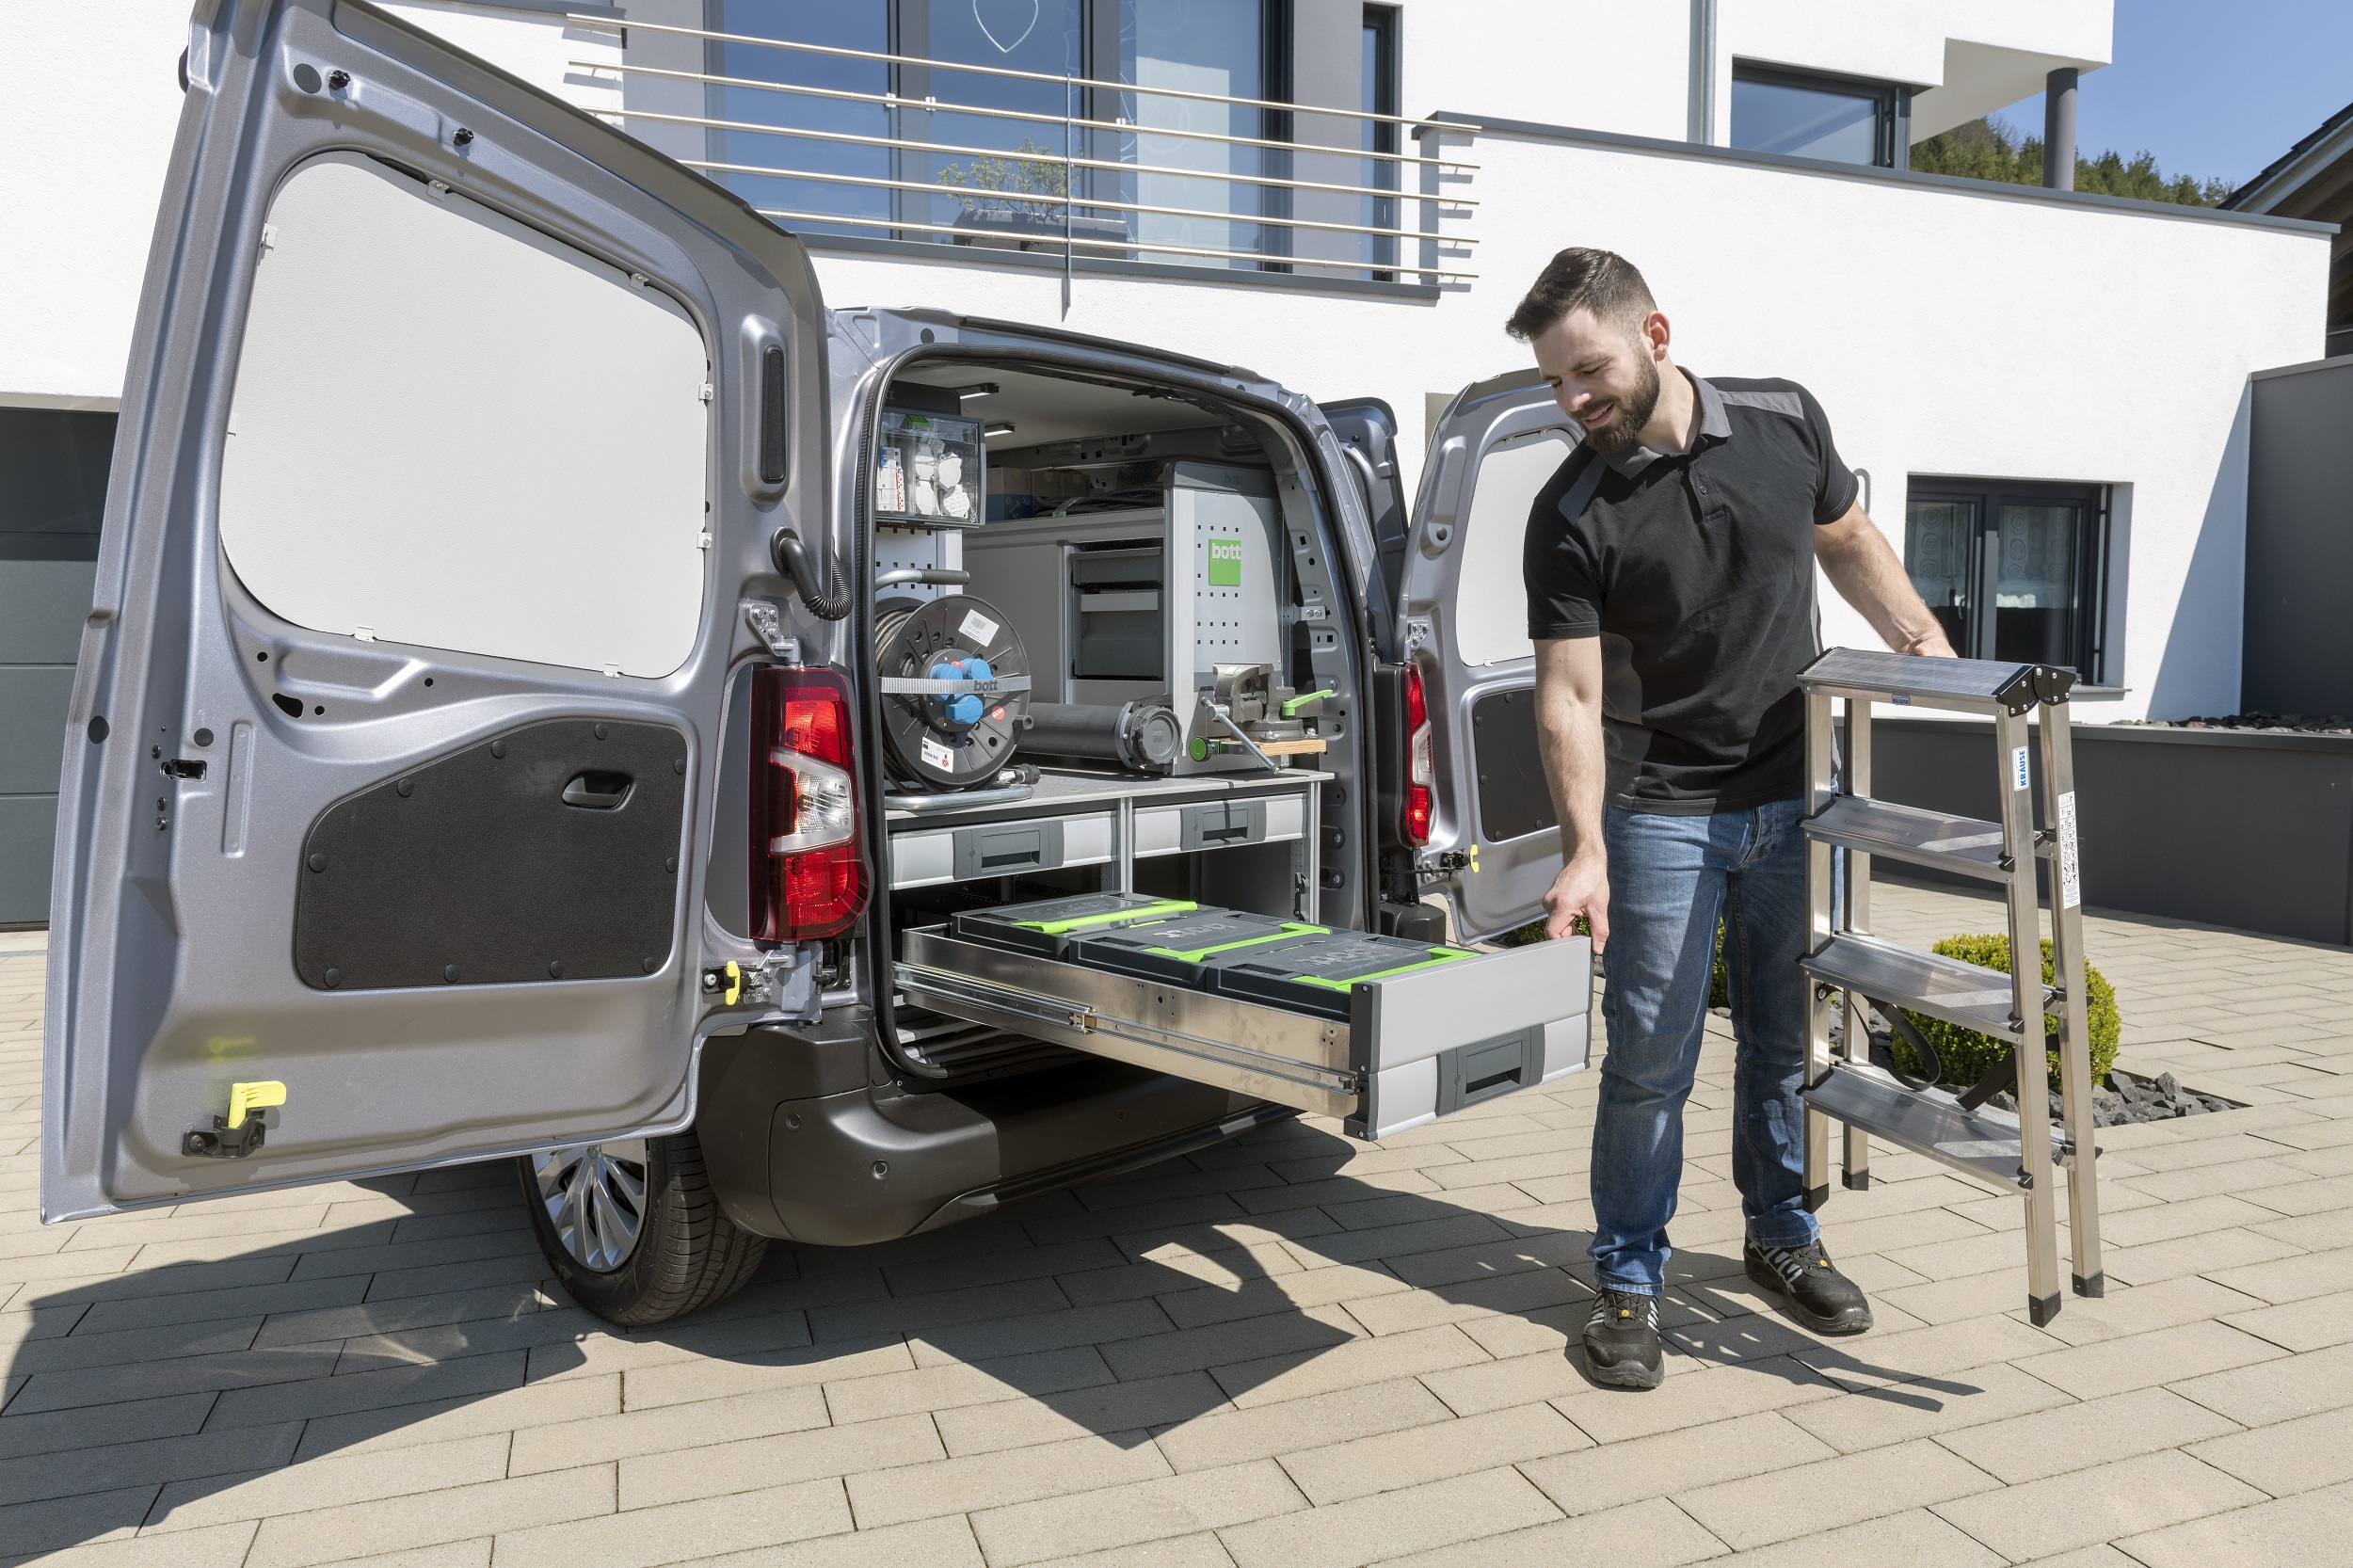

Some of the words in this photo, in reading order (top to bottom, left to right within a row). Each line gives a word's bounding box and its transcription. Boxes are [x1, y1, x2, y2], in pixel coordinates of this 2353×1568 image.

[1211, 542, 1241, 560] bott
[973, 680, 998, 691] bott
[2019, 749, 2027, 787] KRAUSE
